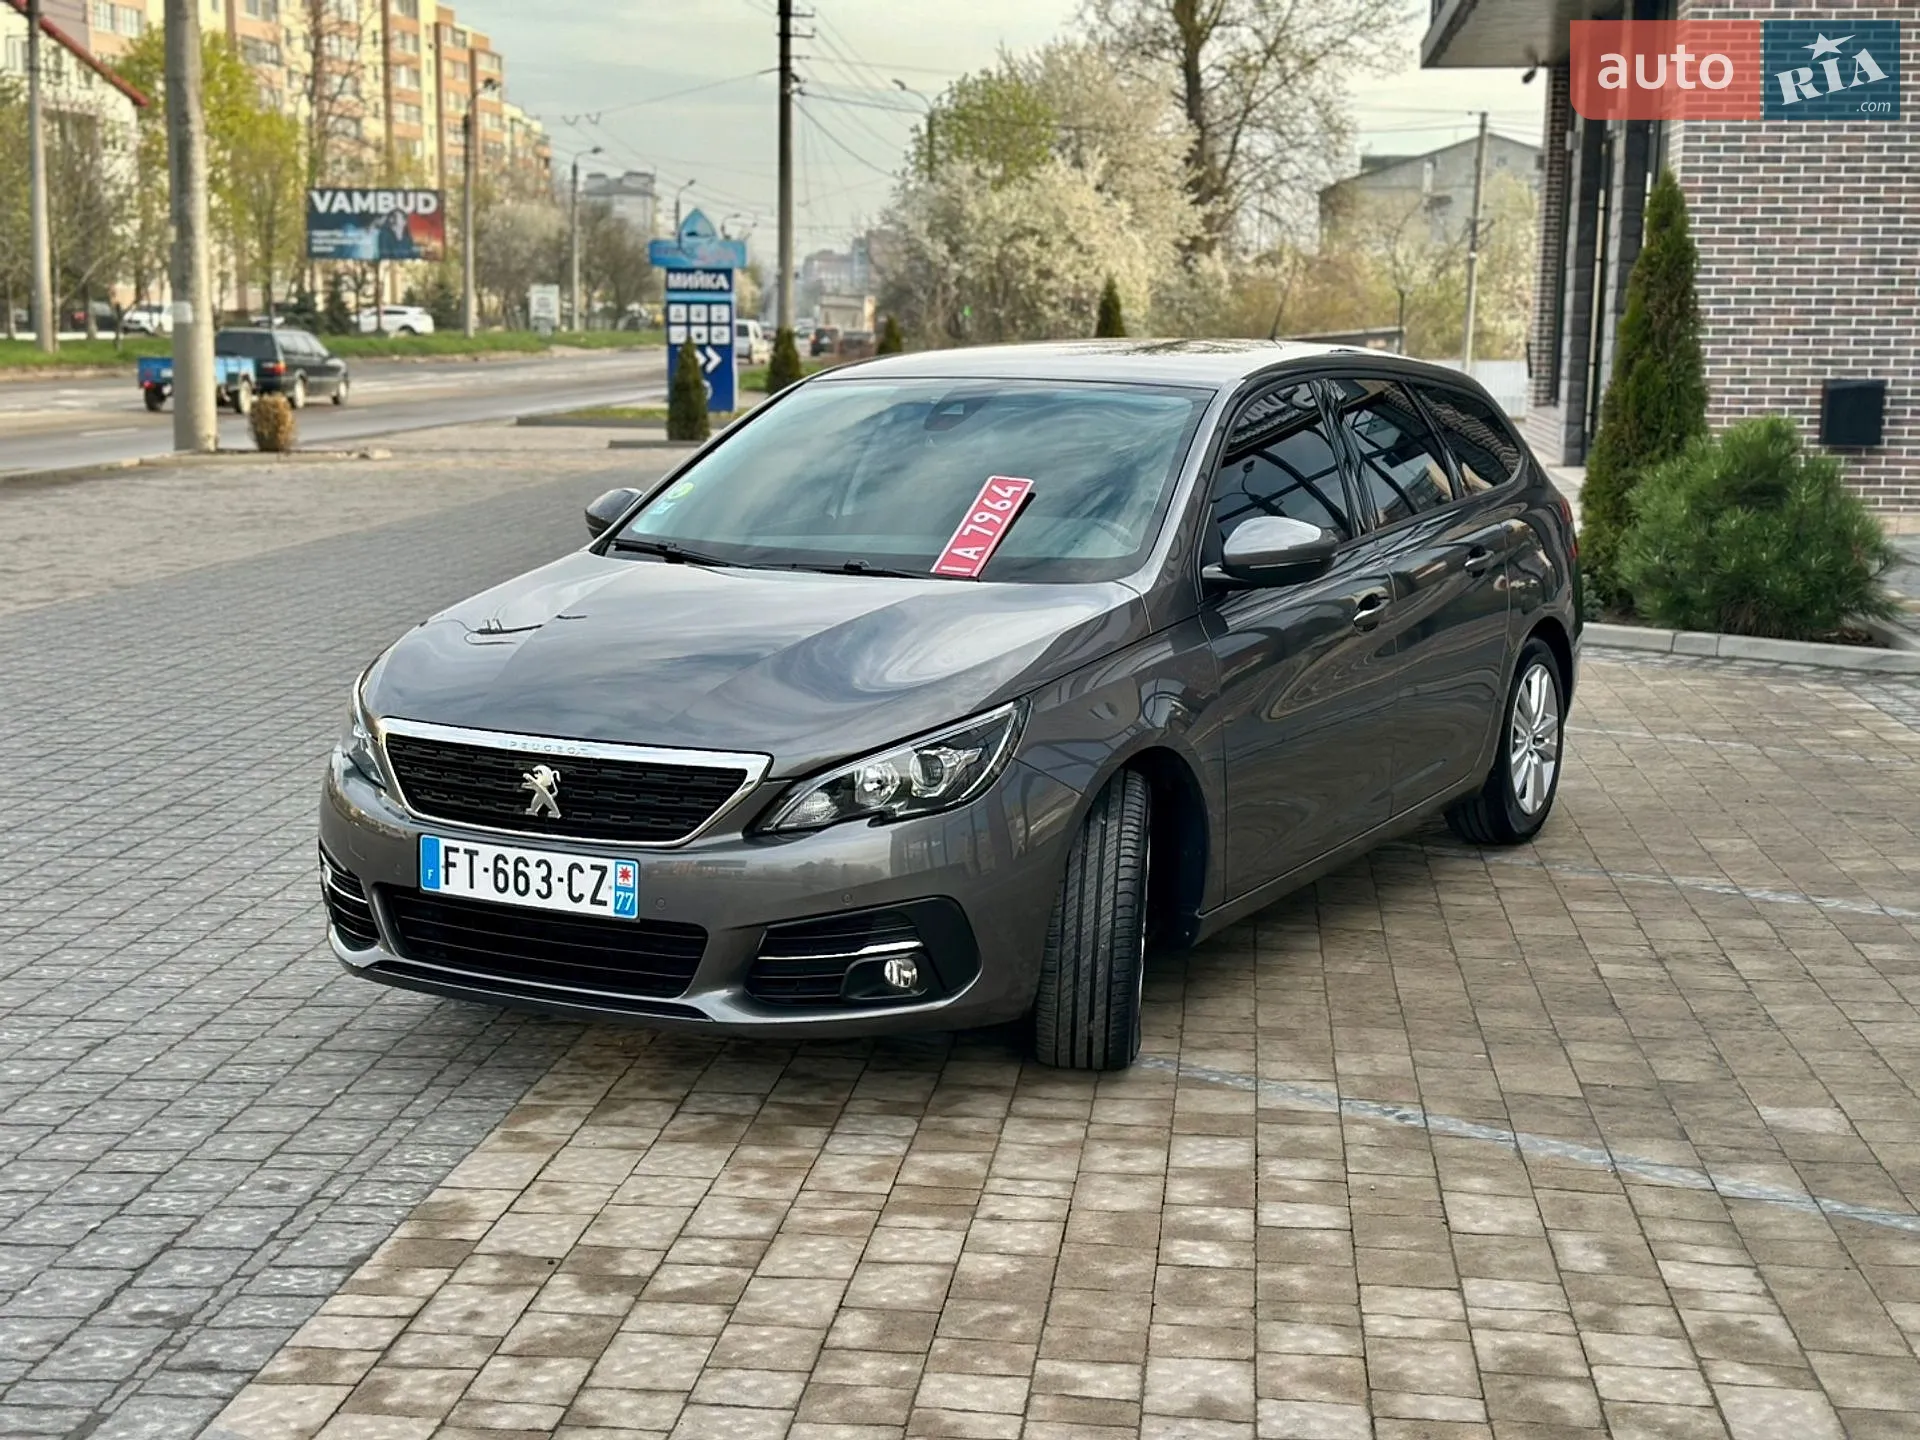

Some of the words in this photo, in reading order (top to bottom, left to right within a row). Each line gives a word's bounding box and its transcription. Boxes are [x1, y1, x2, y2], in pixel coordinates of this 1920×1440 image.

[310, 190, 438, 214] VAMBUD
[667, 270, 730, 290] МИЙКА
[961, 484, 1023, 537] 7964
[426, 868, 434, 881] F
[443, 845, 609, 907] FT-663-CZ
[616, 891, 634, 911] 77
